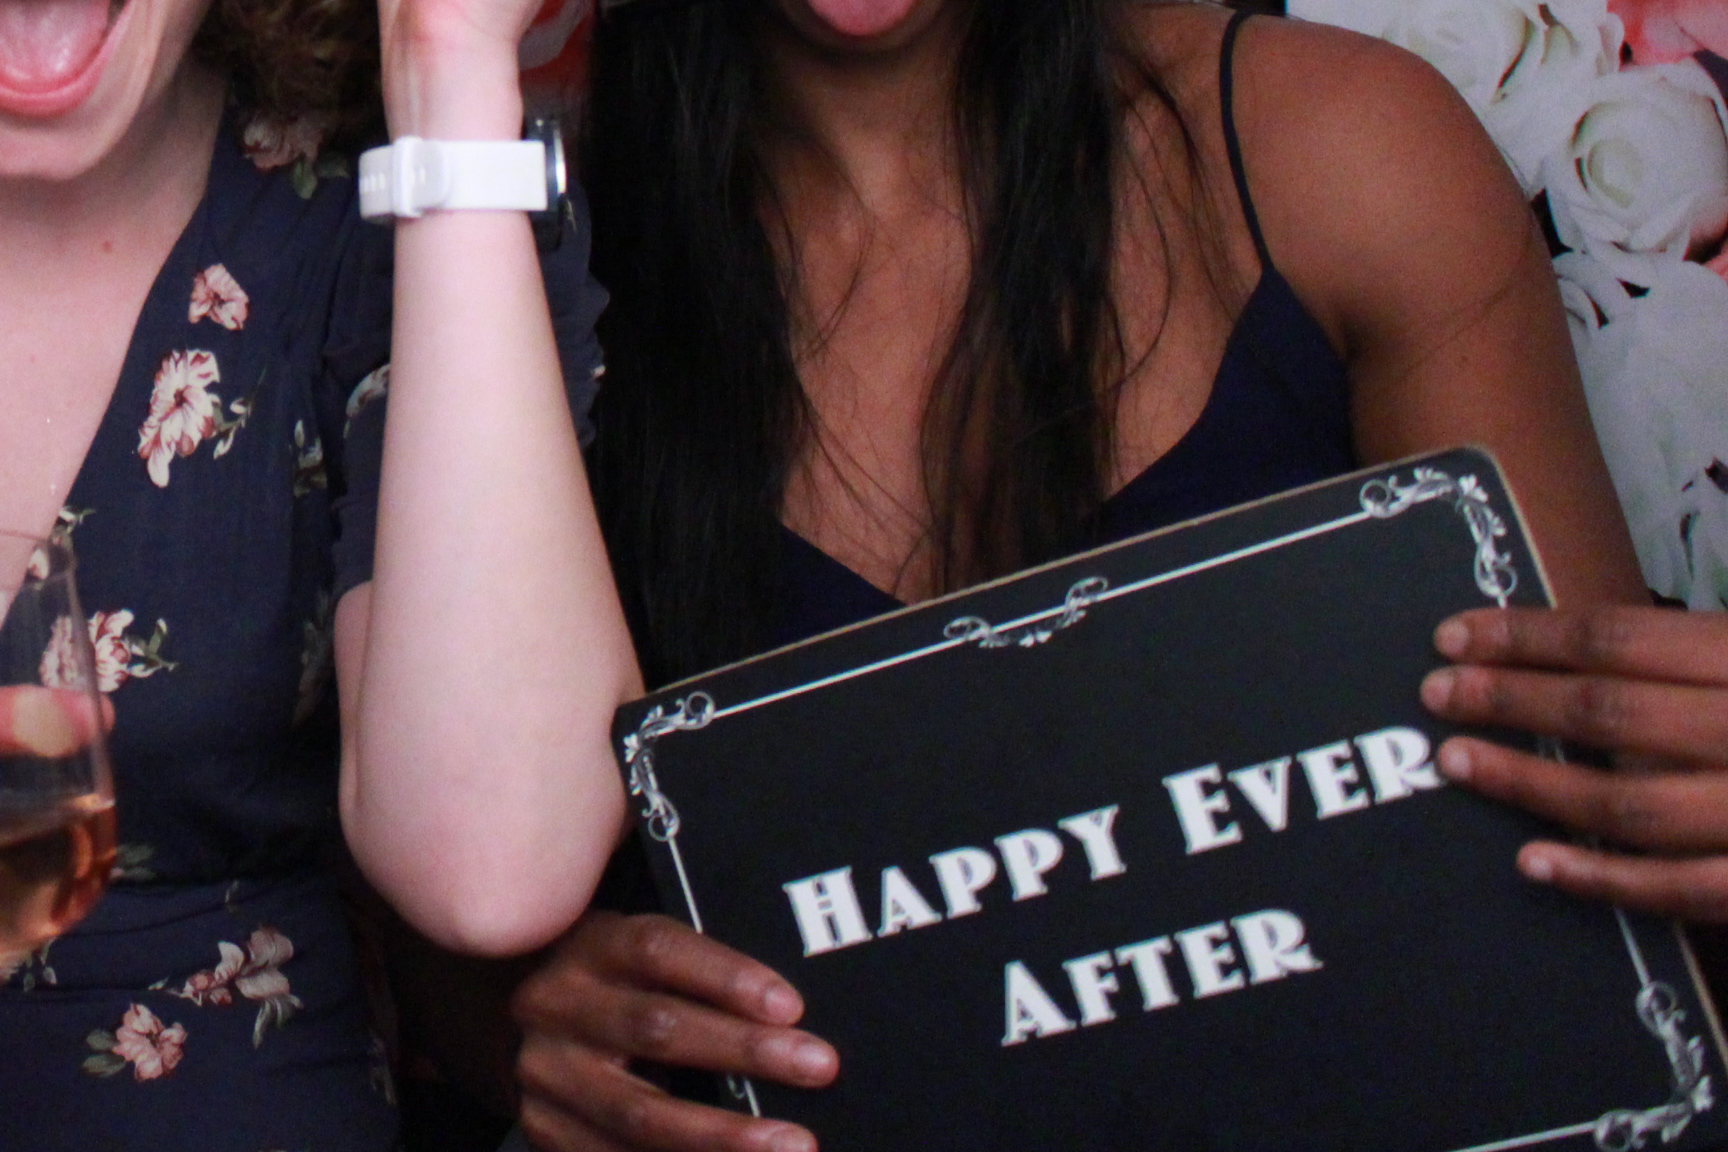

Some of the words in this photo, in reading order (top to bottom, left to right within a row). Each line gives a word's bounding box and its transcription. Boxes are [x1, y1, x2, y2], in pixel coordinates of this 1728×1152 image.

[781, 804, 1127, 958] HAPPY
[1161, 725, 1448, 855] EVER
[1000, 908, 1324, 1047] AFTER
